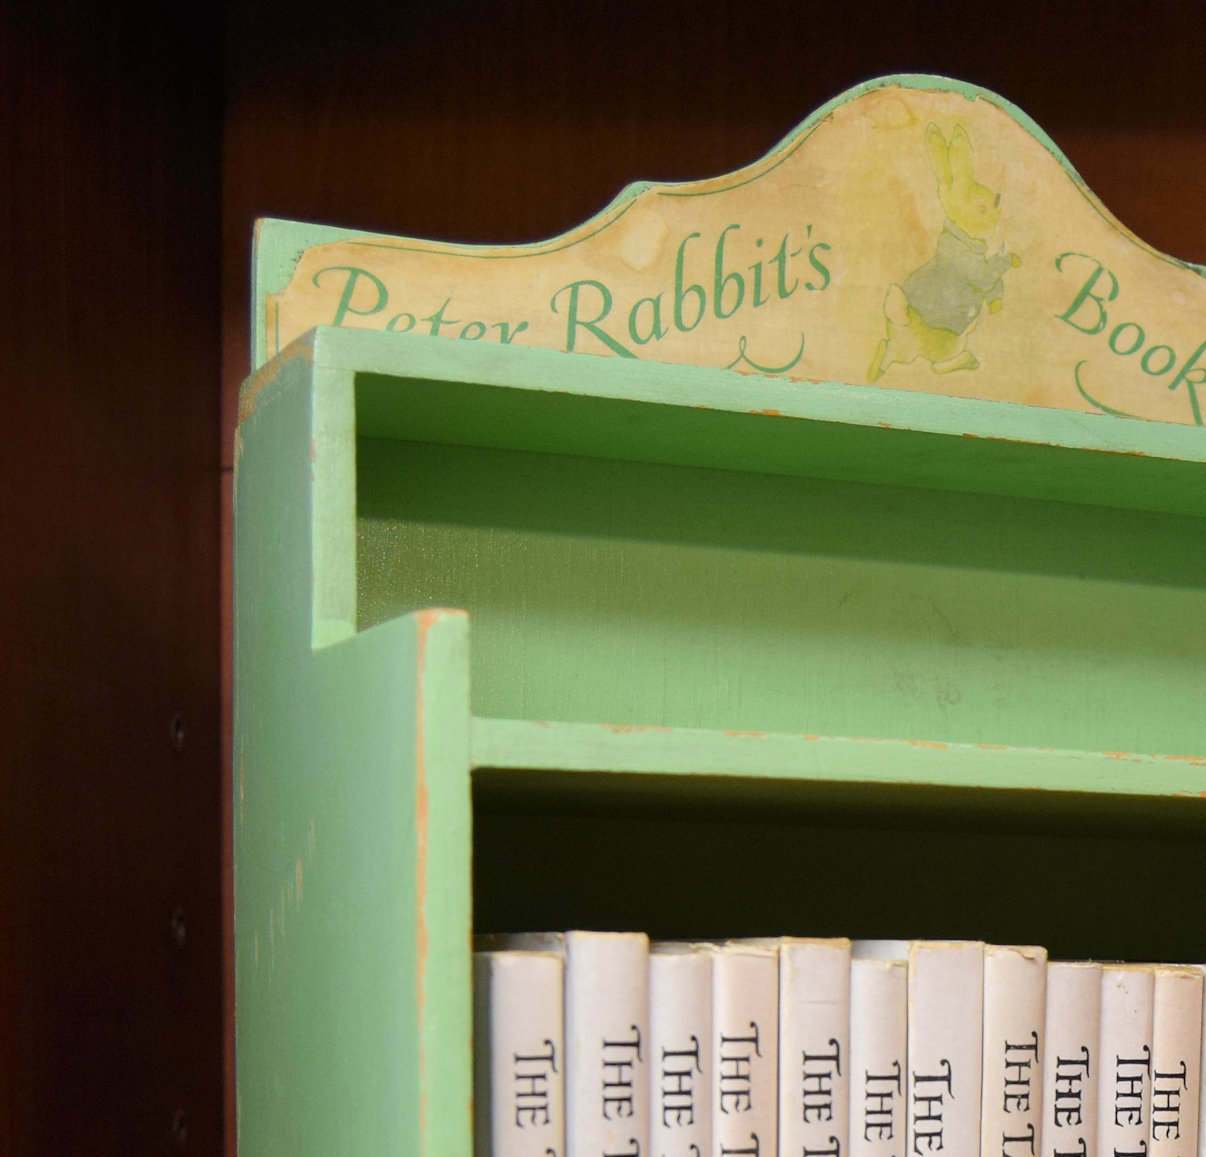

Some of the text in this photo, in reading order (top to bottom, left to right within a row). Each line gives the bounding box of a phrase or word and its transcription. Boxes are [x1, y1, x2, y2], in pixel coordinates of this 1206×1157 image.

[312, 267, 529, 344] Peter
[549, 223, 832, 359] Rabbit's
[514, 1039, 557, 1127] THE
[603, 1025, 642, 1120] THE
[662, 1035, 701, 1128] THE
[720, 1021, 761, 1114] THE
[803, 1038, 841, 1123] THE
[864, 1060, 901, 1142] THE
[913, 1059, 954, 1156] THE
[1003, 1031, 1039, 1113] THE
[1054, 1046, 1089, 1127] THE
[1115, 1045, 1151, 1127] THE
[1152, 1061, 1187, 1141] THE
